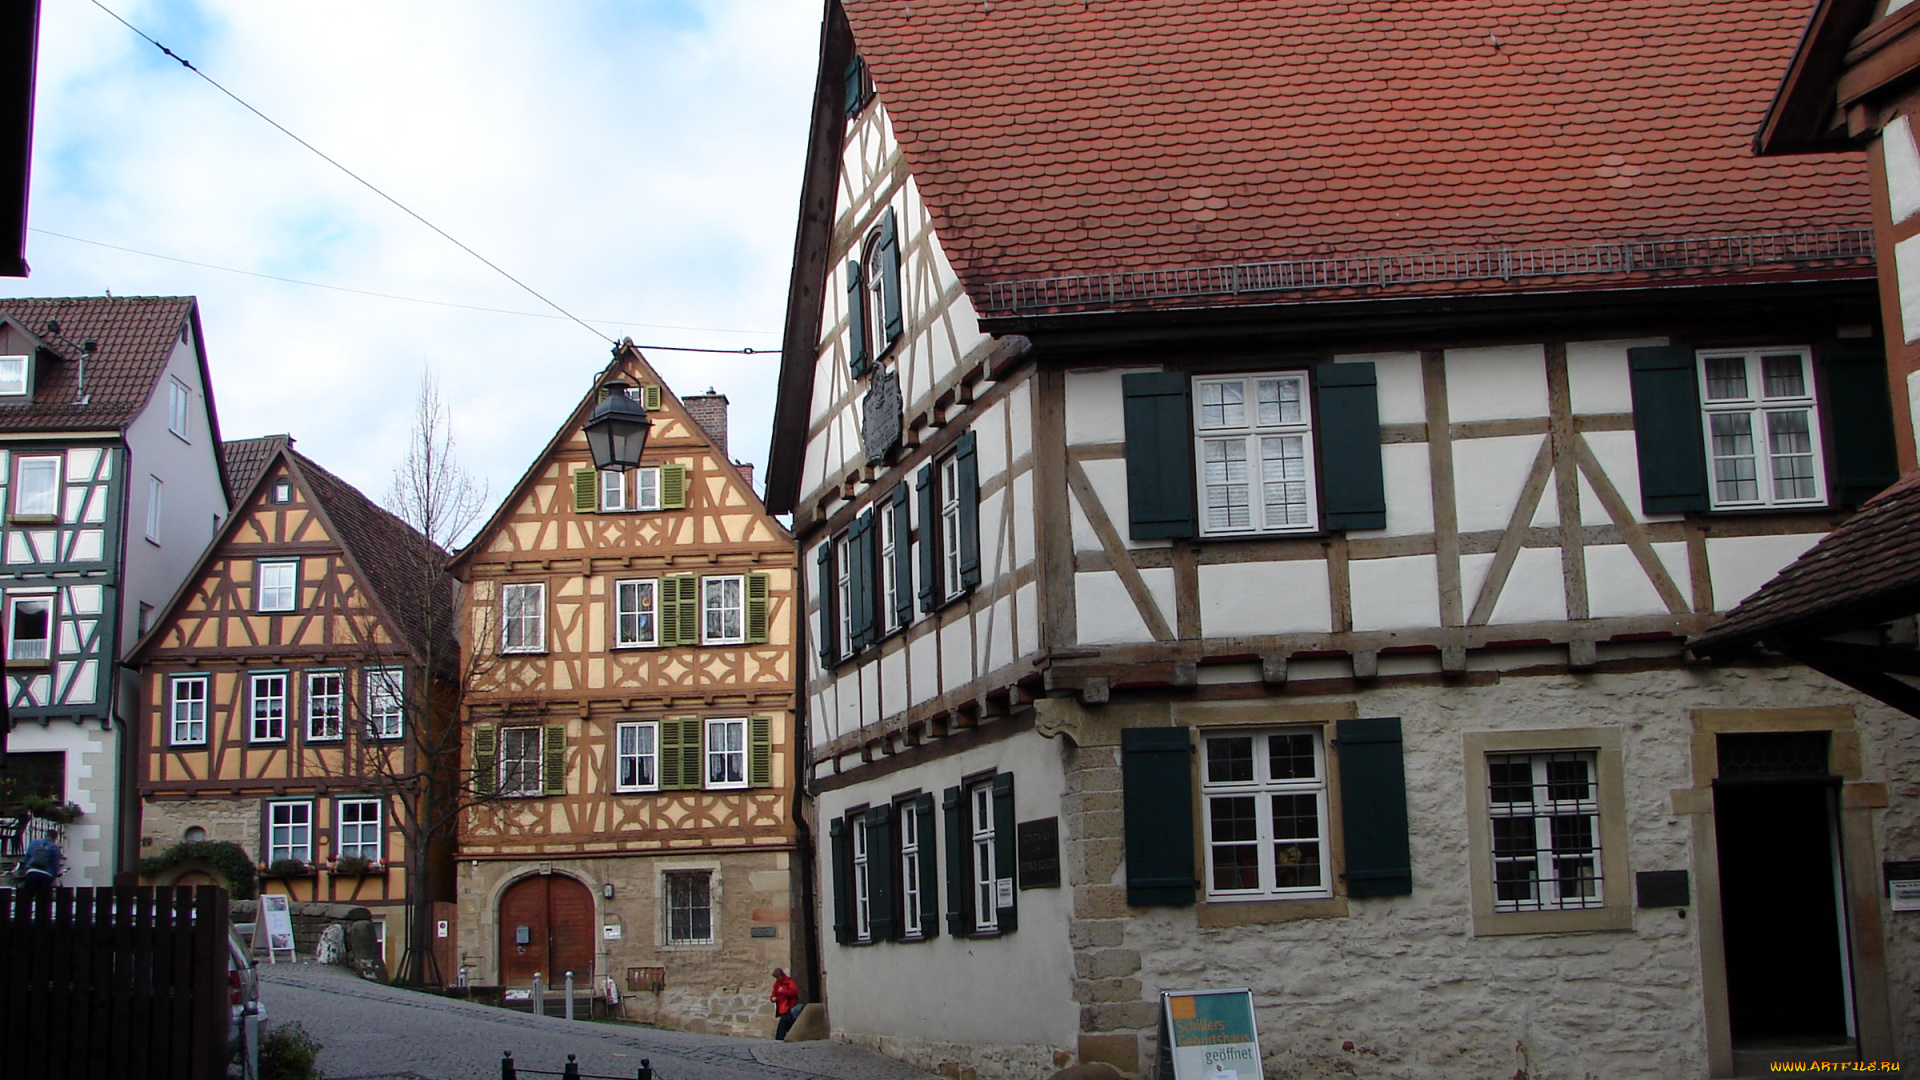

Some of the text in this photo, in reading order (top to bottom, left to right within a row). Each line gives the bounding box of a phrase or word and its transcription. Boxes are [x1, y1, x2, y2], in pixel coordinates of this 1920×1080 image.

[1176, 1019, 1225, 1033] Schillers
[1178, 1033, 1250, 1046] Geburtshaus
[1205, 1047, 1253, 1064] geöffnet
